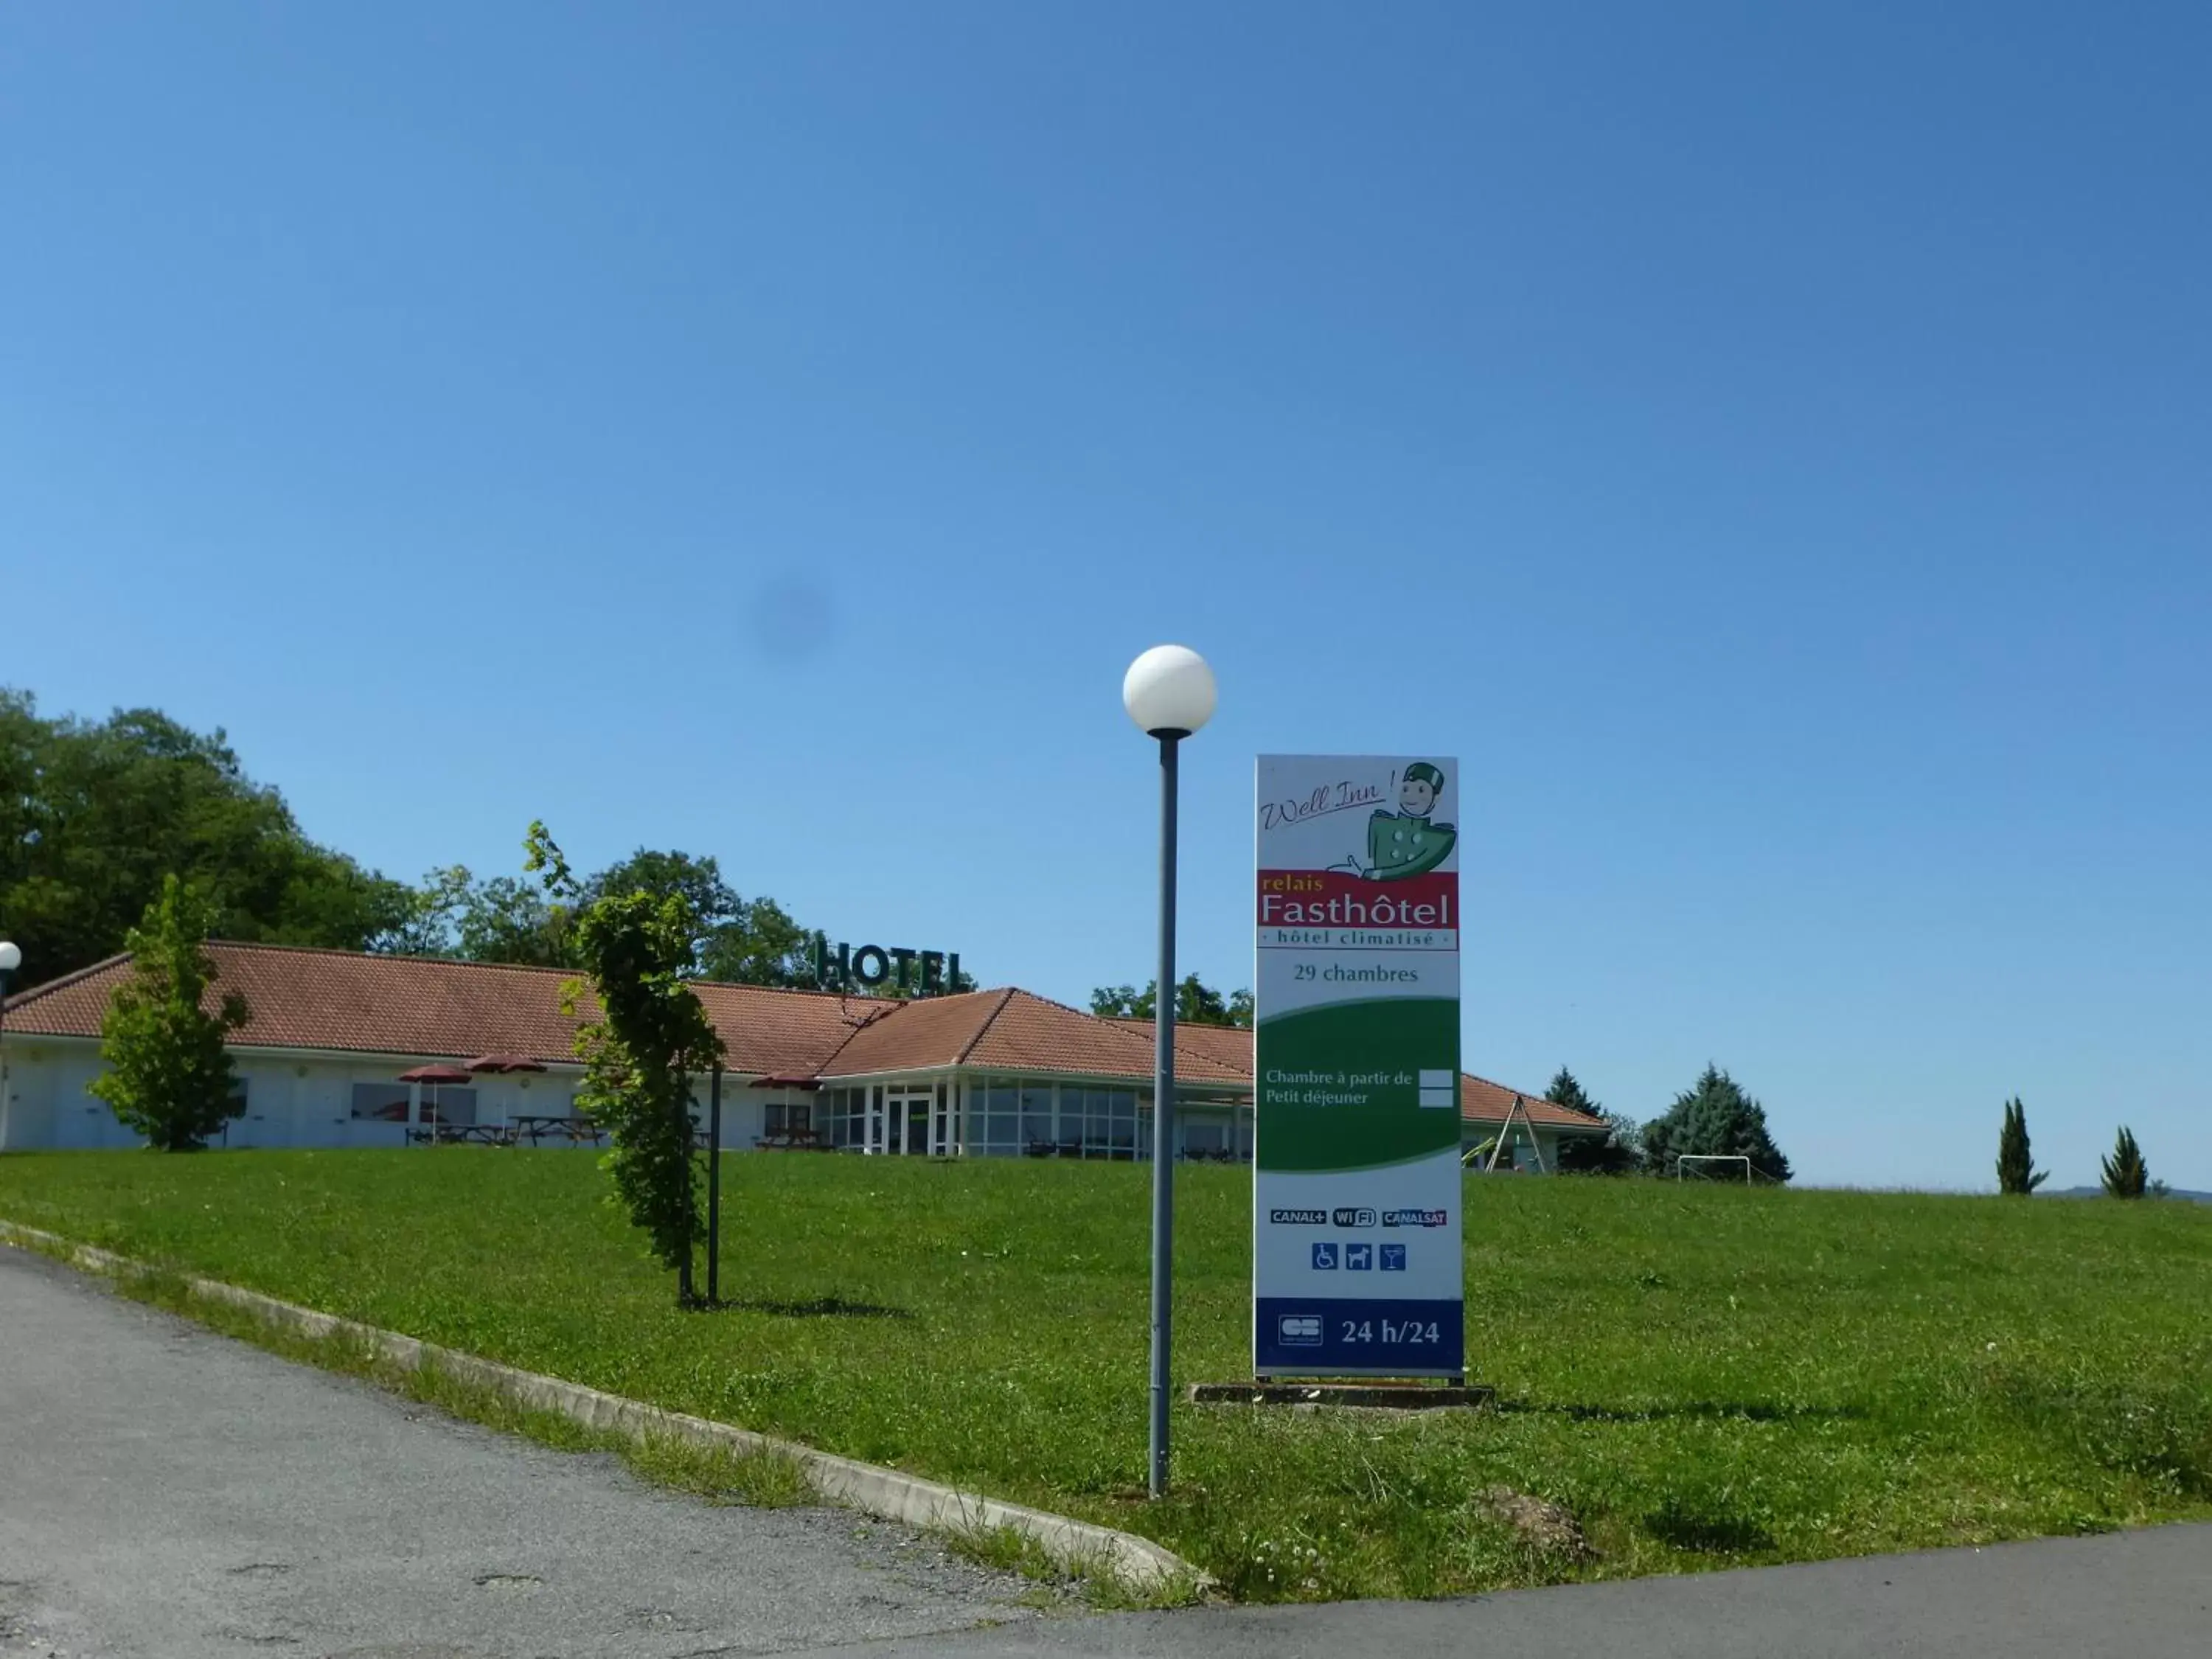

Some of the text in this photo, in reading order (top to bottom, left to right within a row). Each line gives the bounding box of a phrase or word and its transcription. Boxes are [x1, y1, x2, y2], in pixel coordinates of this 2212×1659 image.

[1261, 785, 1330, 830] Well
[1335, 781, 1380, 807] Inn
[1262, 874, 1323, 891] relais
[1262, 894, 1448, 925] Fasthôtel
[1278, 929, 1434, 945] hôtel climatisé
[815, 929, 970, 992] HOTEL
[1294, 963, 1418, 981] 29 chambres
[1266, 1070, 1412, 1088] Chambre à partir de
[1266, 1090, 1368, 1106] Petit déjeuner
[1273, 1212, 1325, 1222] CANAL+
[1385, 1212, 1444, 1223] CANALSAT
[1342, 1320, 1439, 1343] 24 h/24
